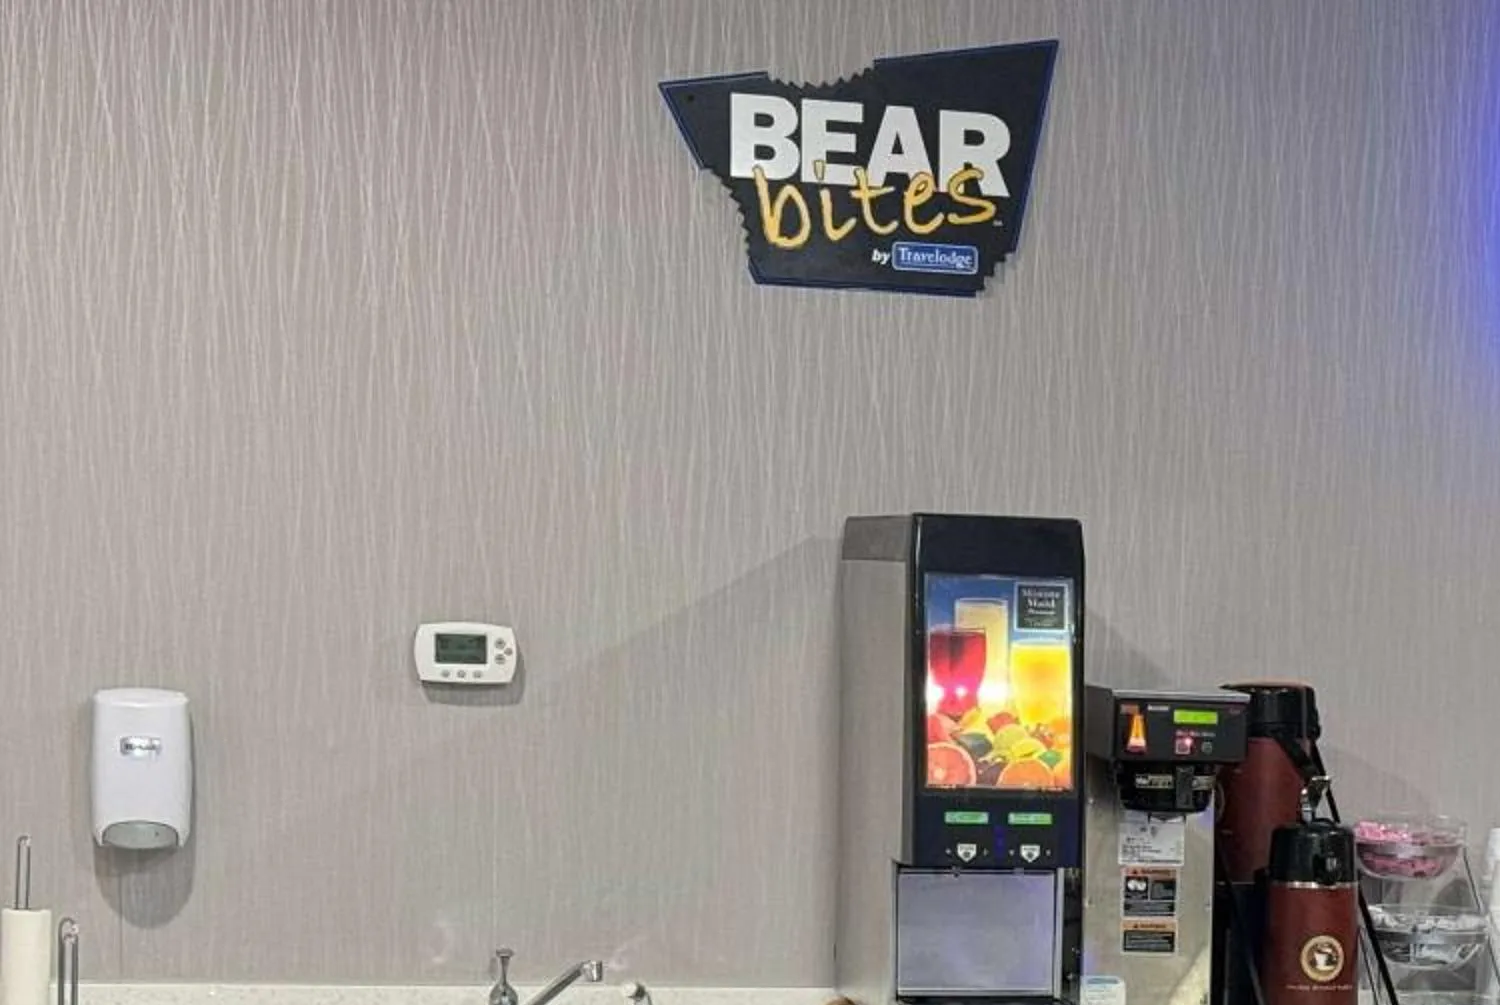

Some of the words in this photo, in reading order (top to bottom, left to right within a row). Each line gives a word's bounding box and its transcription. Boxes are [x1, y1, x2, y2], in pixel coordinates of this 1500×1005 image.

[730, 92, 1011, 198] BEAR
[753, 160, 997, 249] bites
[871, 248, 891, 265] by
[898, 246, 973, 270] Travelodge
